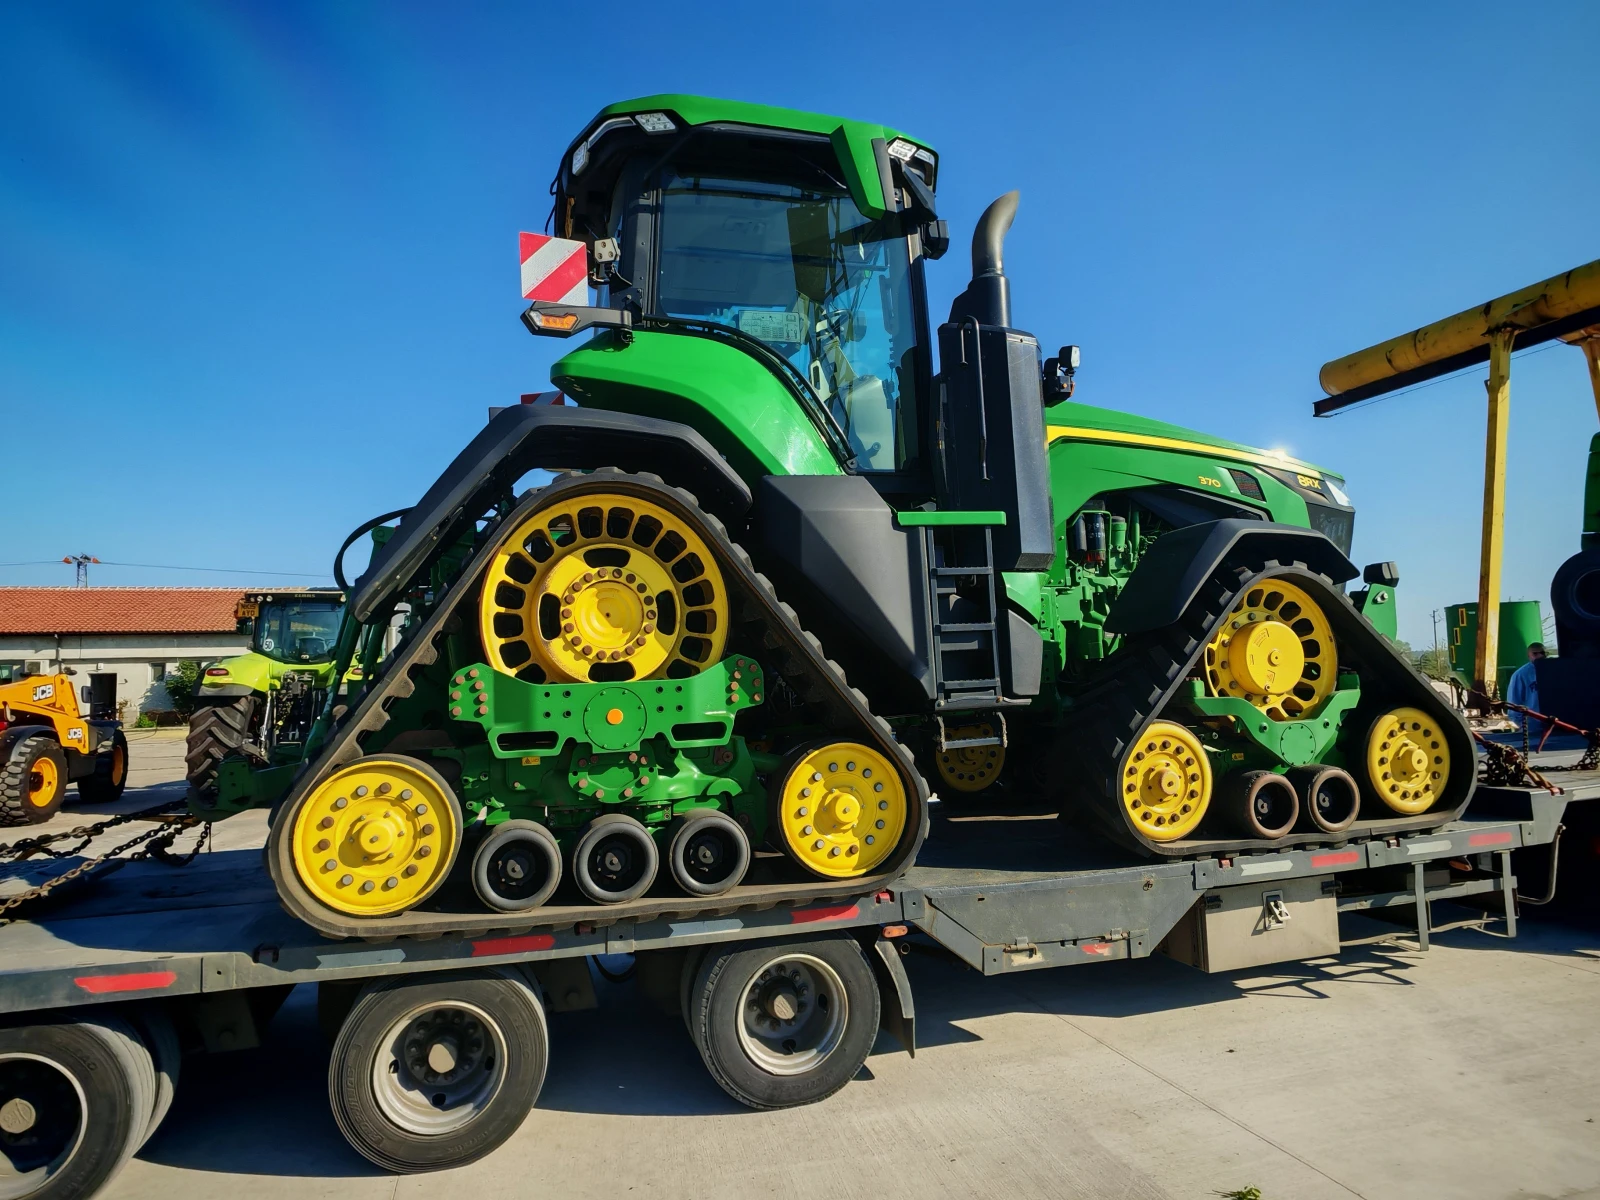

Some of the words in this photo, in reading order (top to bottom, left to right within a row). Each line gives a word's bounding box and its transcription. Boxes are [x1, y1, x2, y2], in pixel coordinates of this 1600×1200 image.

[1198, 476, 1222, 488] 370
[1296, 474, 1322, 490] 8RX
[264, 640, 273, 650] 50
[33, 684, 53, 701] JCB
[67, 728, 82, 739] JCB
